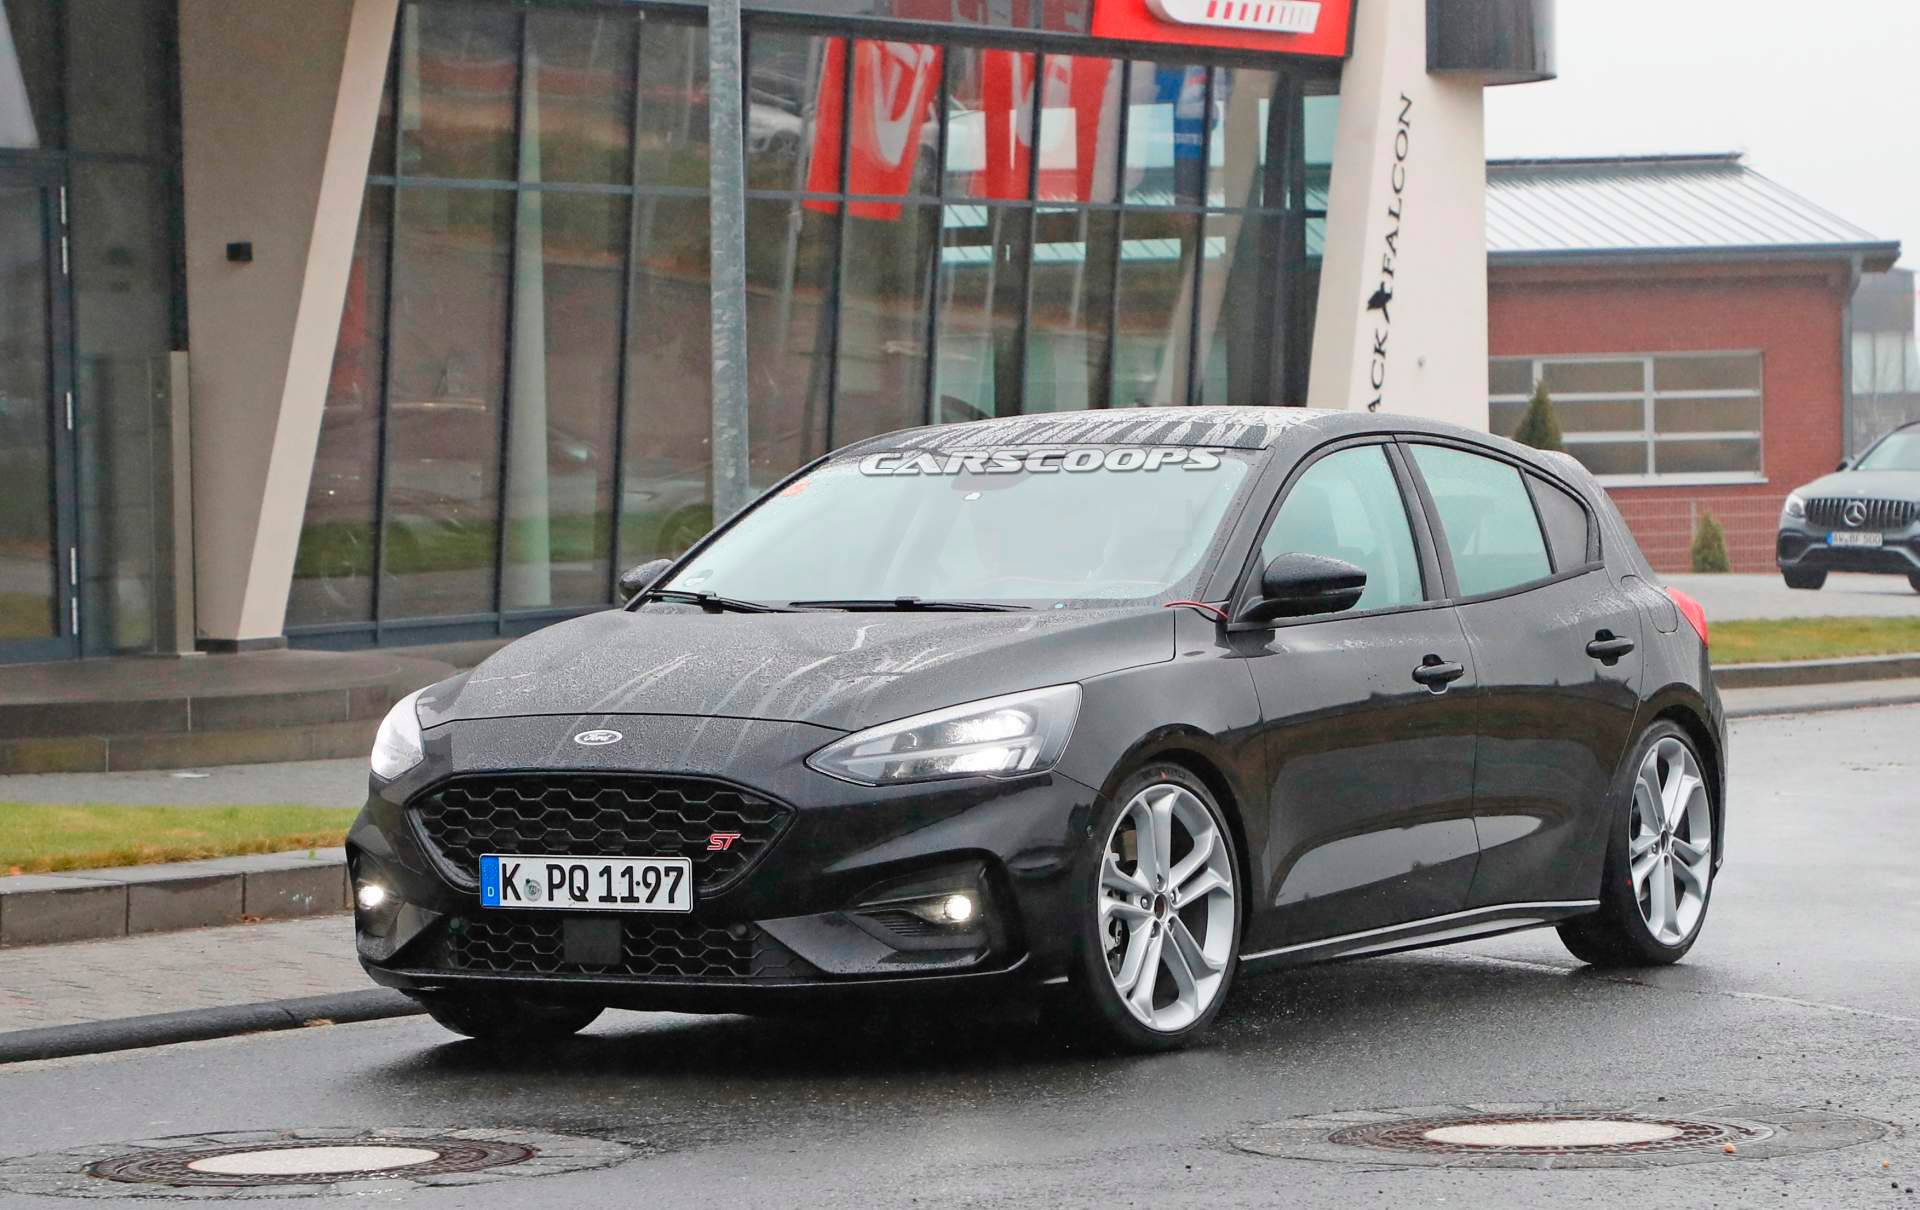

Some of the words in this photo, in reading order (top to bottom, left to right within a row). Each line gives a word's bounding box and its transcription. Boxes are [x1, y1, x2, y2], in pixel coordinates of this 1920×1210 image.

[1380, 92, 1414, 278] FALCON
[706, 833, 741, 851] ST
[487, 886, 495, 898] D
[501, 863, 521, 901] K
[546, 863, 589, 902] PQ
[598, 865, 685, 904] 1197
